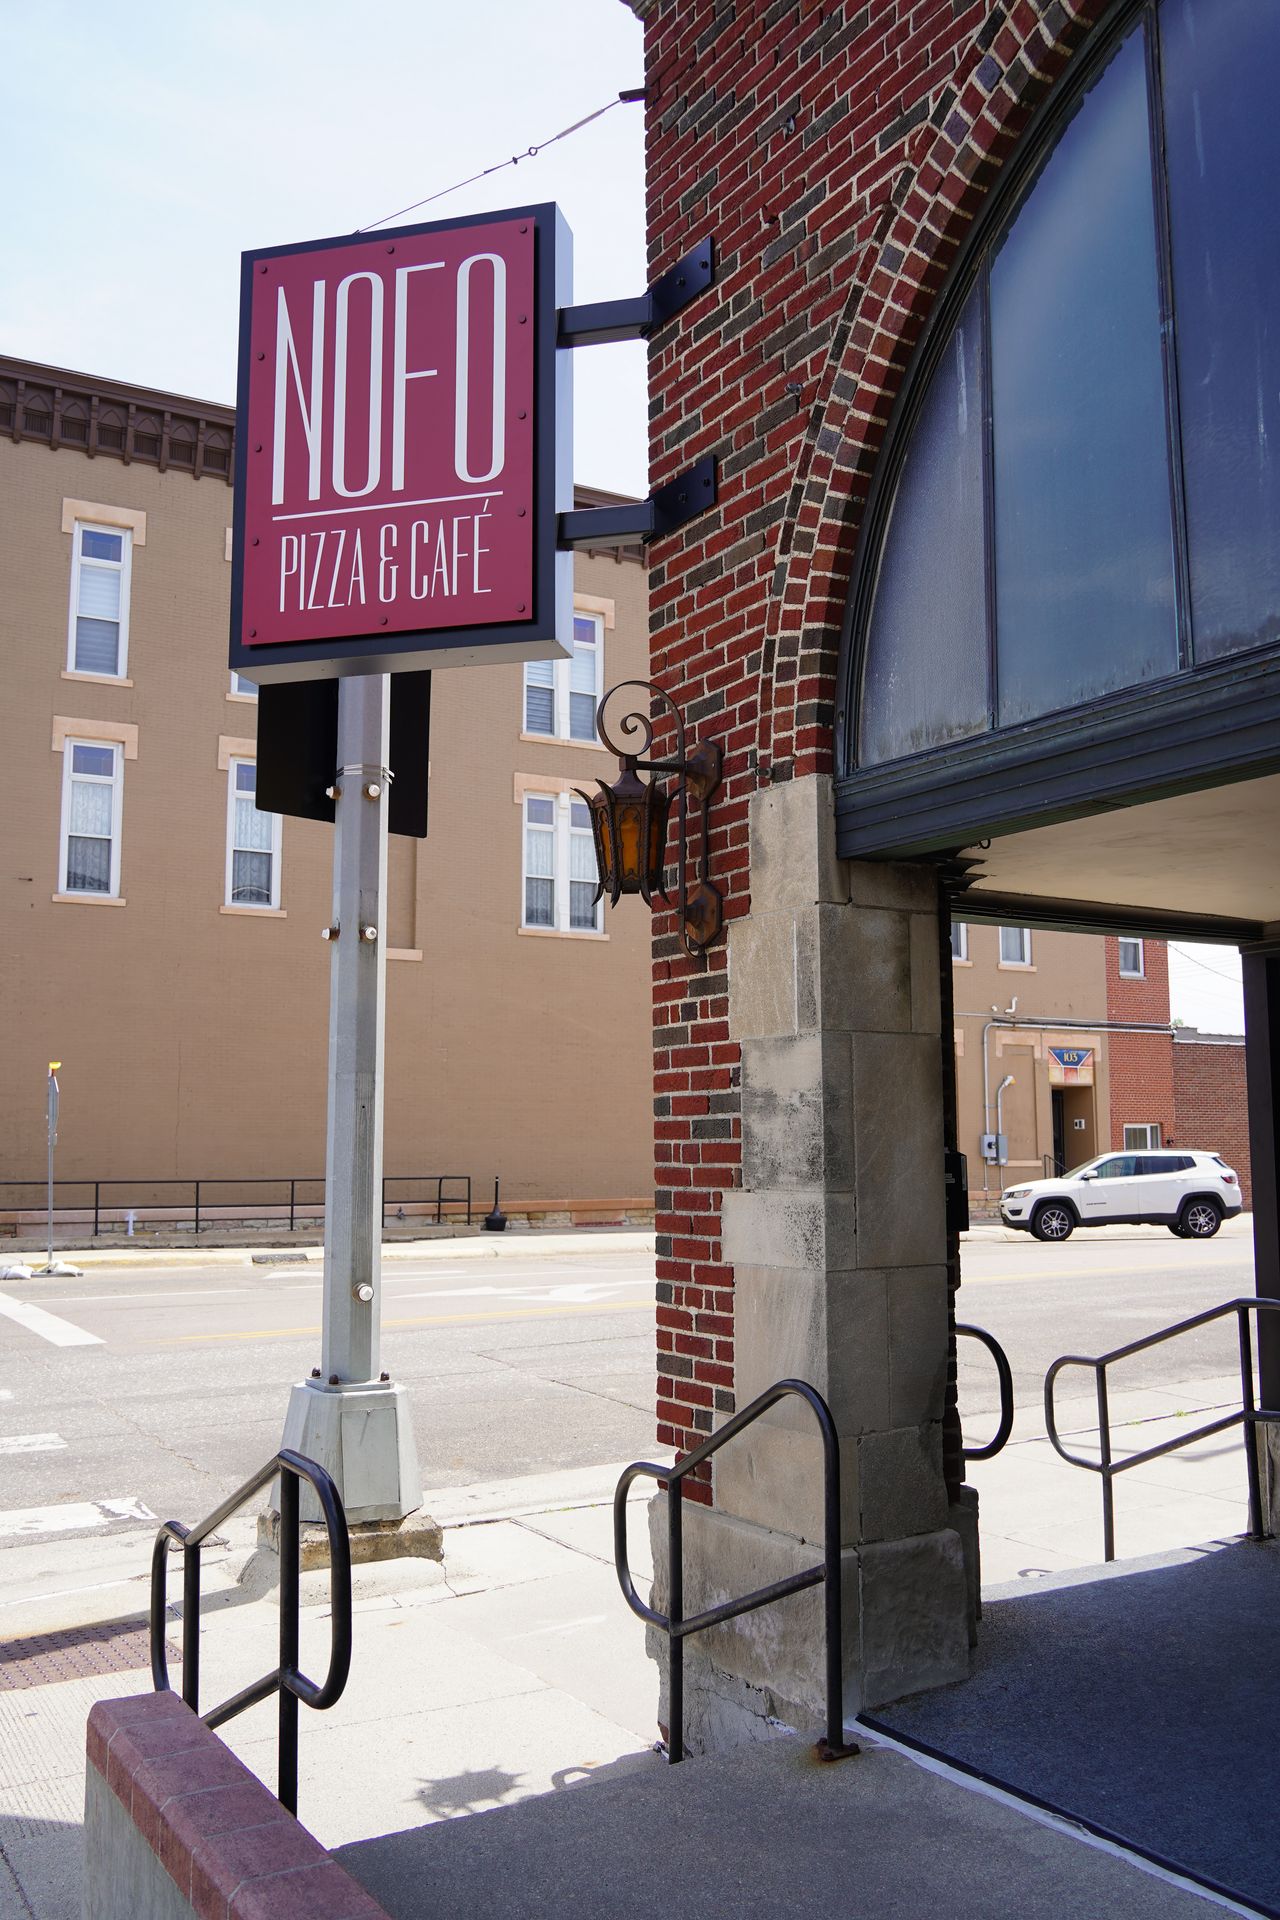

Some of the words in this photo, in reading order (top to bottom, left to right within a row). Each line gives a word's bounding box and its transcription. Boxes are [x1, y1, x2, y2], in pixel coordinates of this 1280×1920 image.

[271, 253, 506, 505] NOFO
[279, 527, 366, 613] PIZZA
[378, 523, 399, 603] &
[410, 498, 493, 600] CAFÉ
